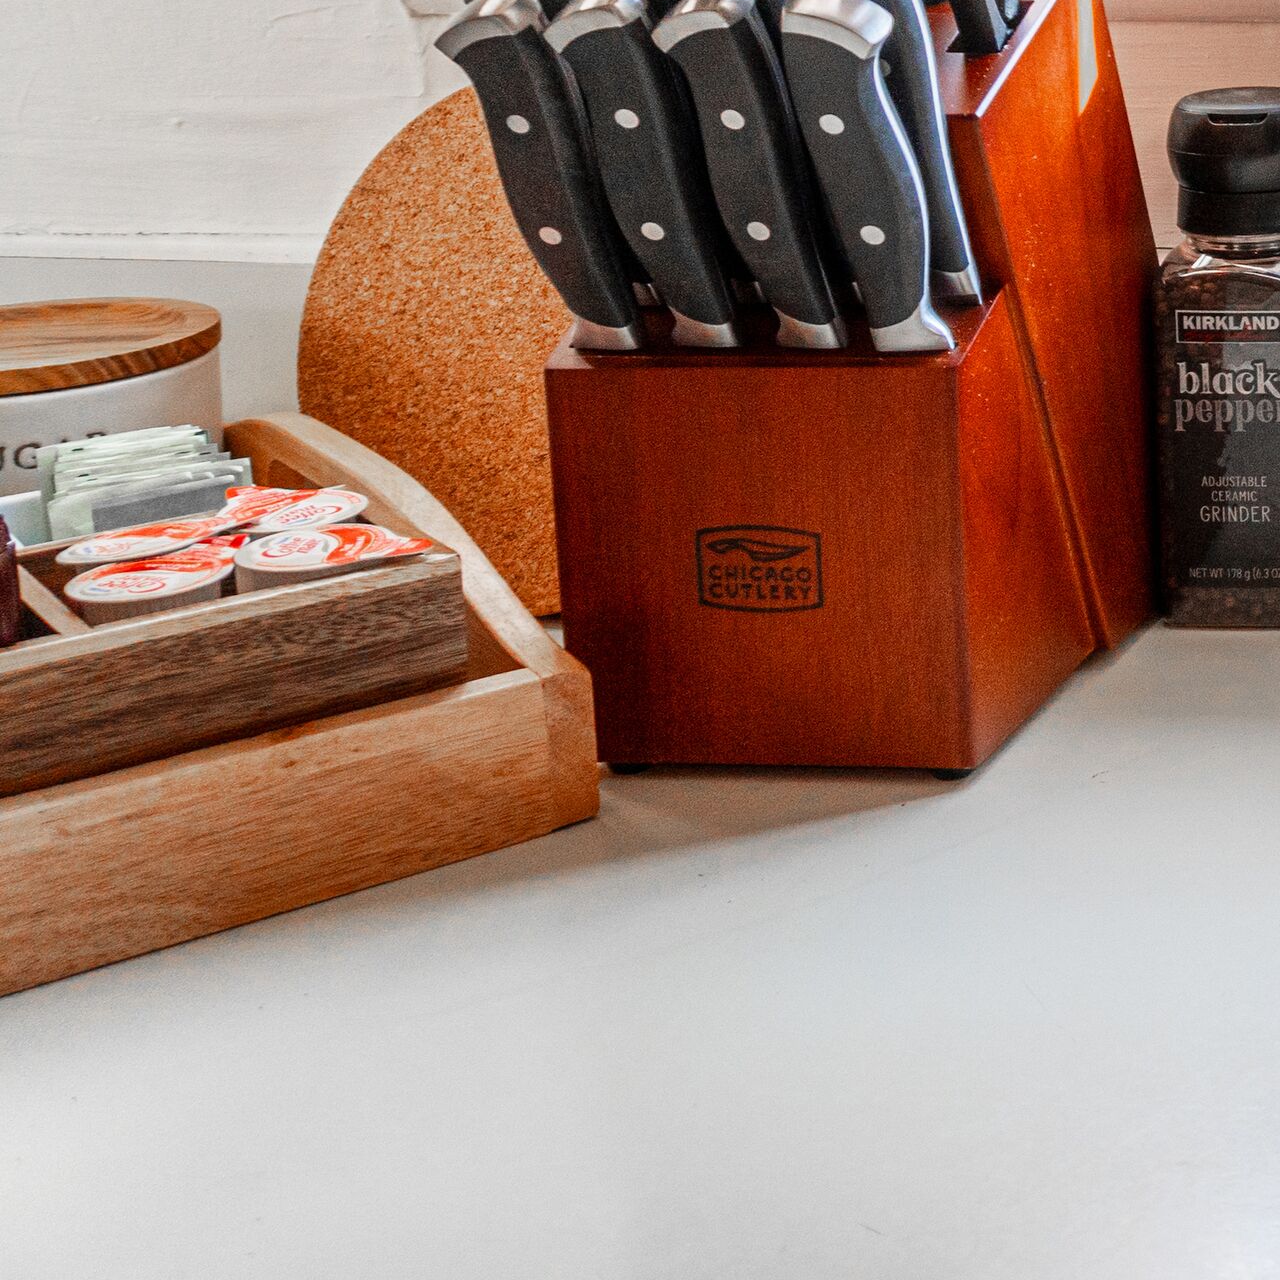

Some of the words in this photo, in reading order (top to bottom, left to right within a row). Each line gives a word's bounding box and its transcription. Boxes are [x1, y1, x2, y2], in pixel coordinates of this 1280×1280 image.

[1183, 315, 1280, 330] KIRKLAND
[1201, 475, 1268, 487] ADJUSTABLE
[1211, 490, 1258, 501] CERAMIC
[1200, 505, 1271, 522] GRINDER
[707, 564, 812, 583] CHICAGO
[1189, 567, 1207, 578] NET
[708, 582, 813, 600] CUTLERY
